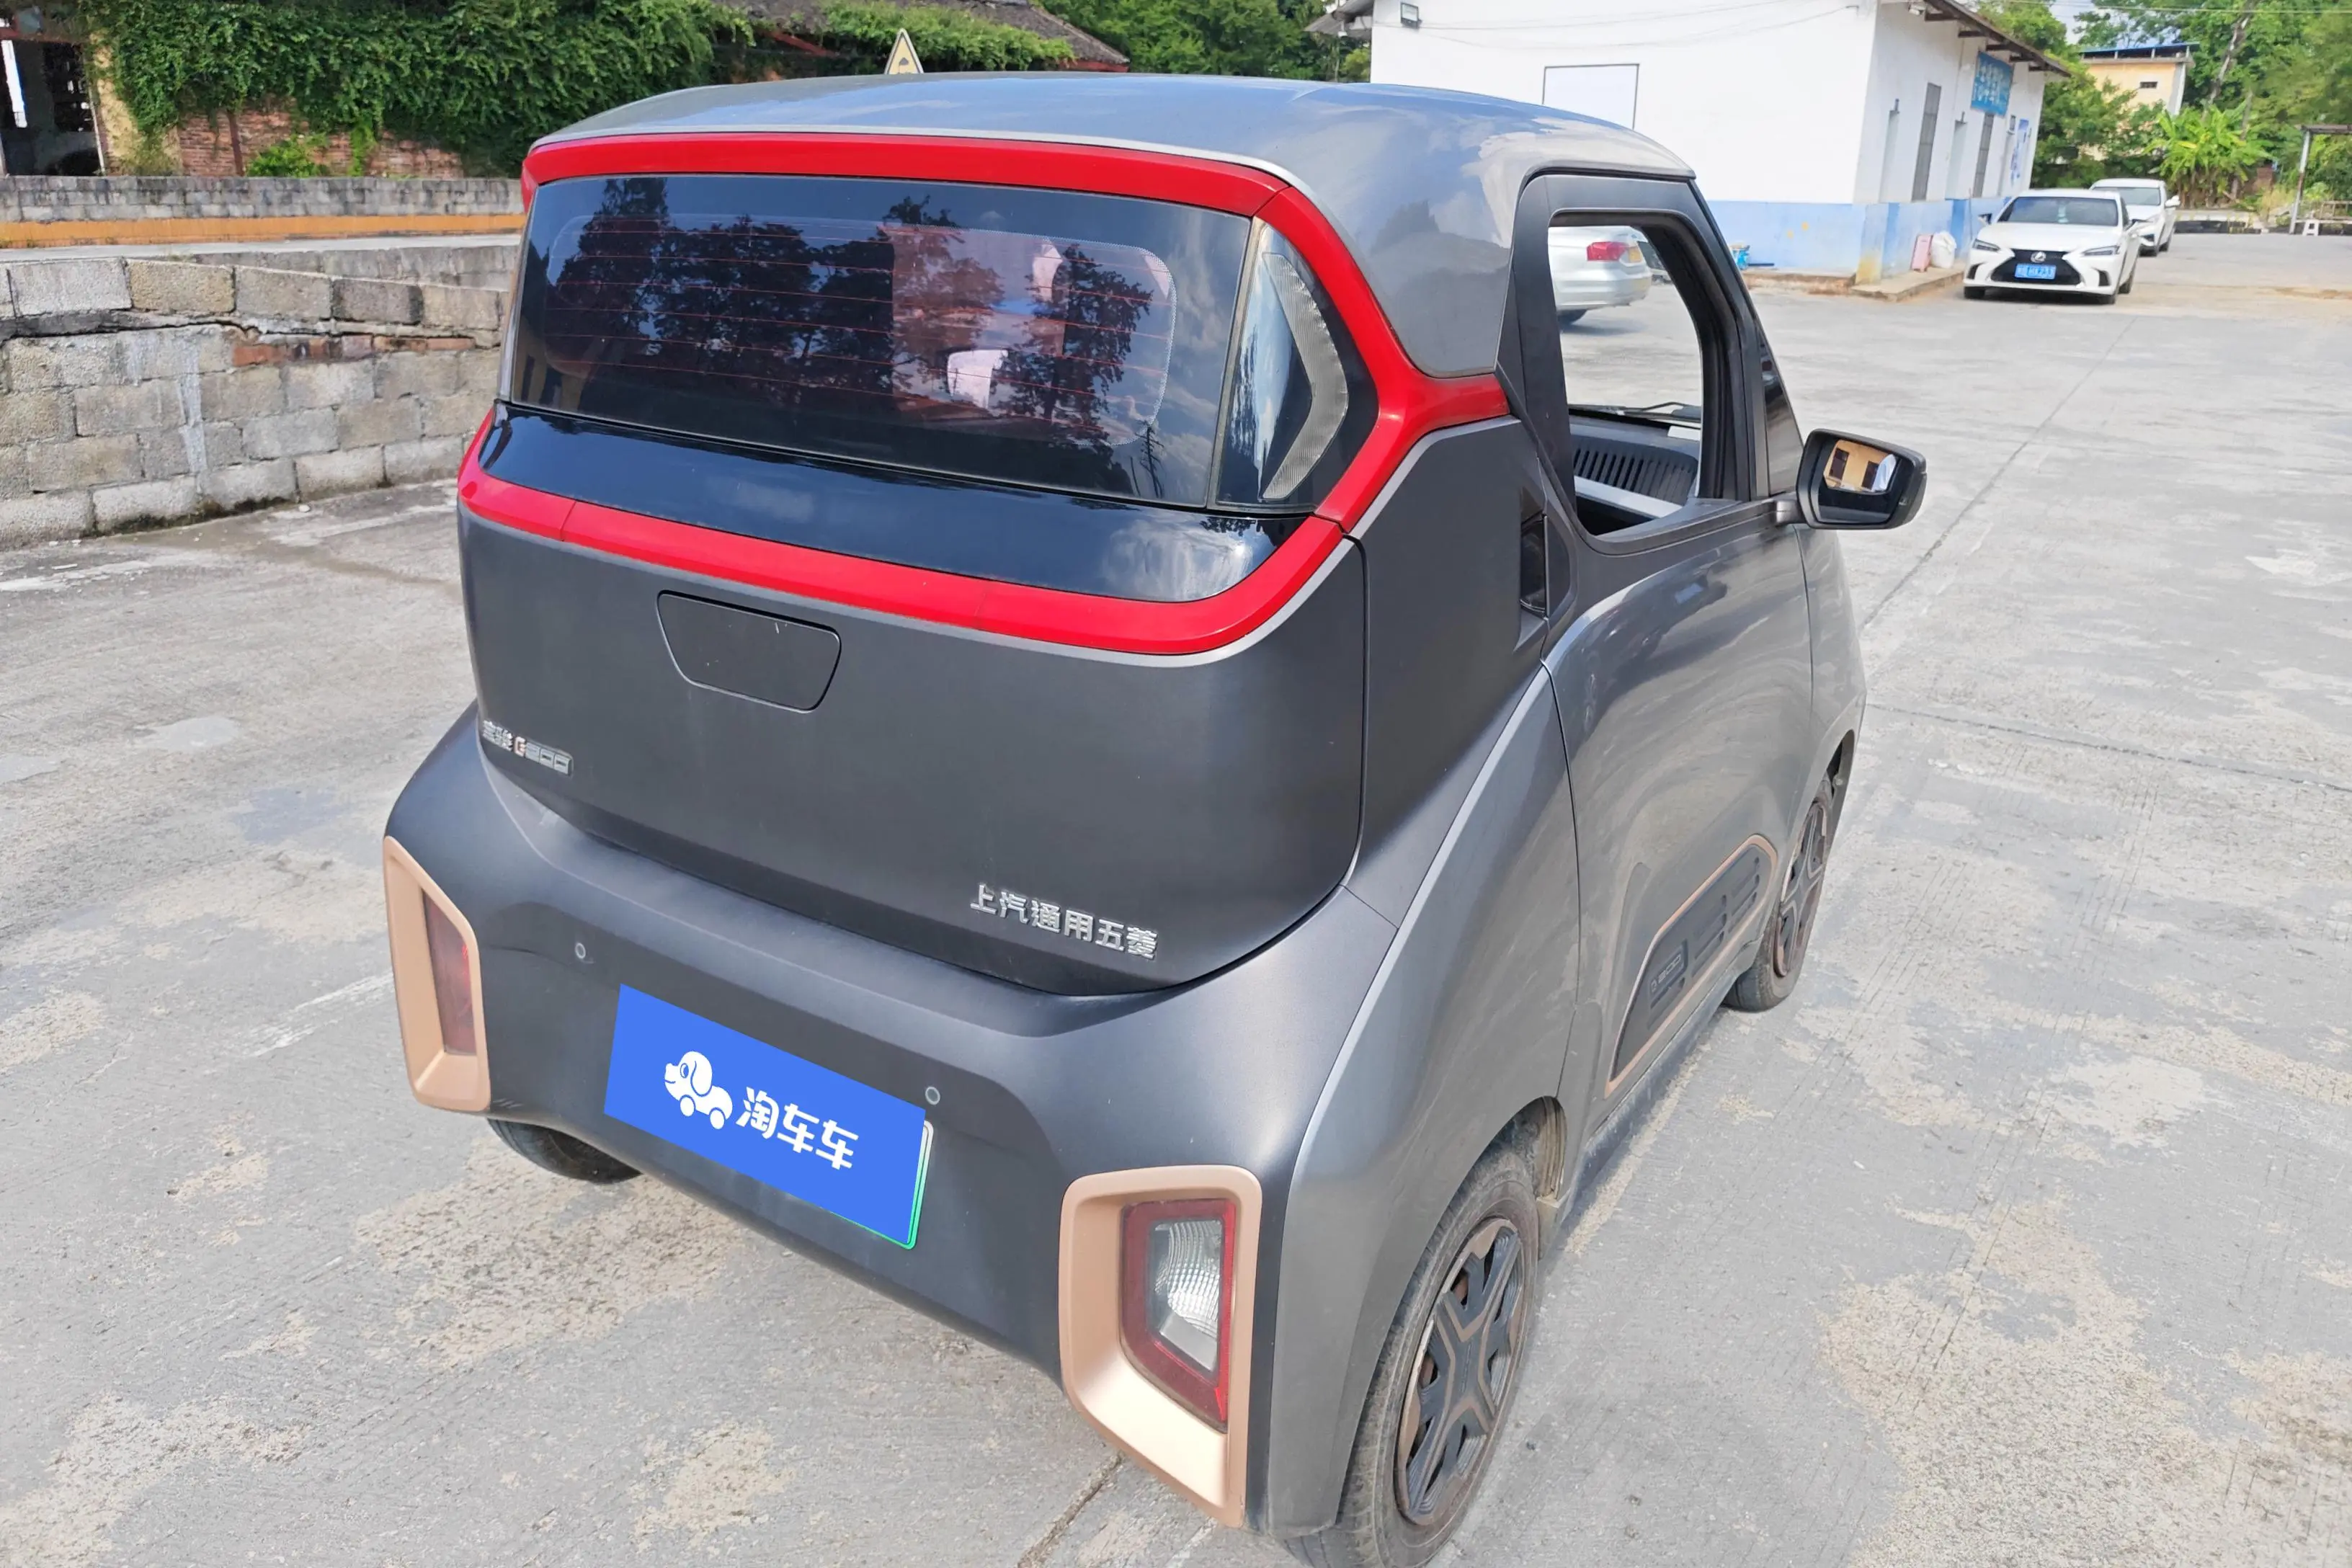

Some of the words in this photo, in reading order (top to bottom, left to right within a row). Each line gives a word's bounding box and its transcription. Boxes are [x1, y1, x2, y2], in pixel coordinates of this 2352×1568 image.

[970, 883, 1157, 960] 上汽通用五菱
